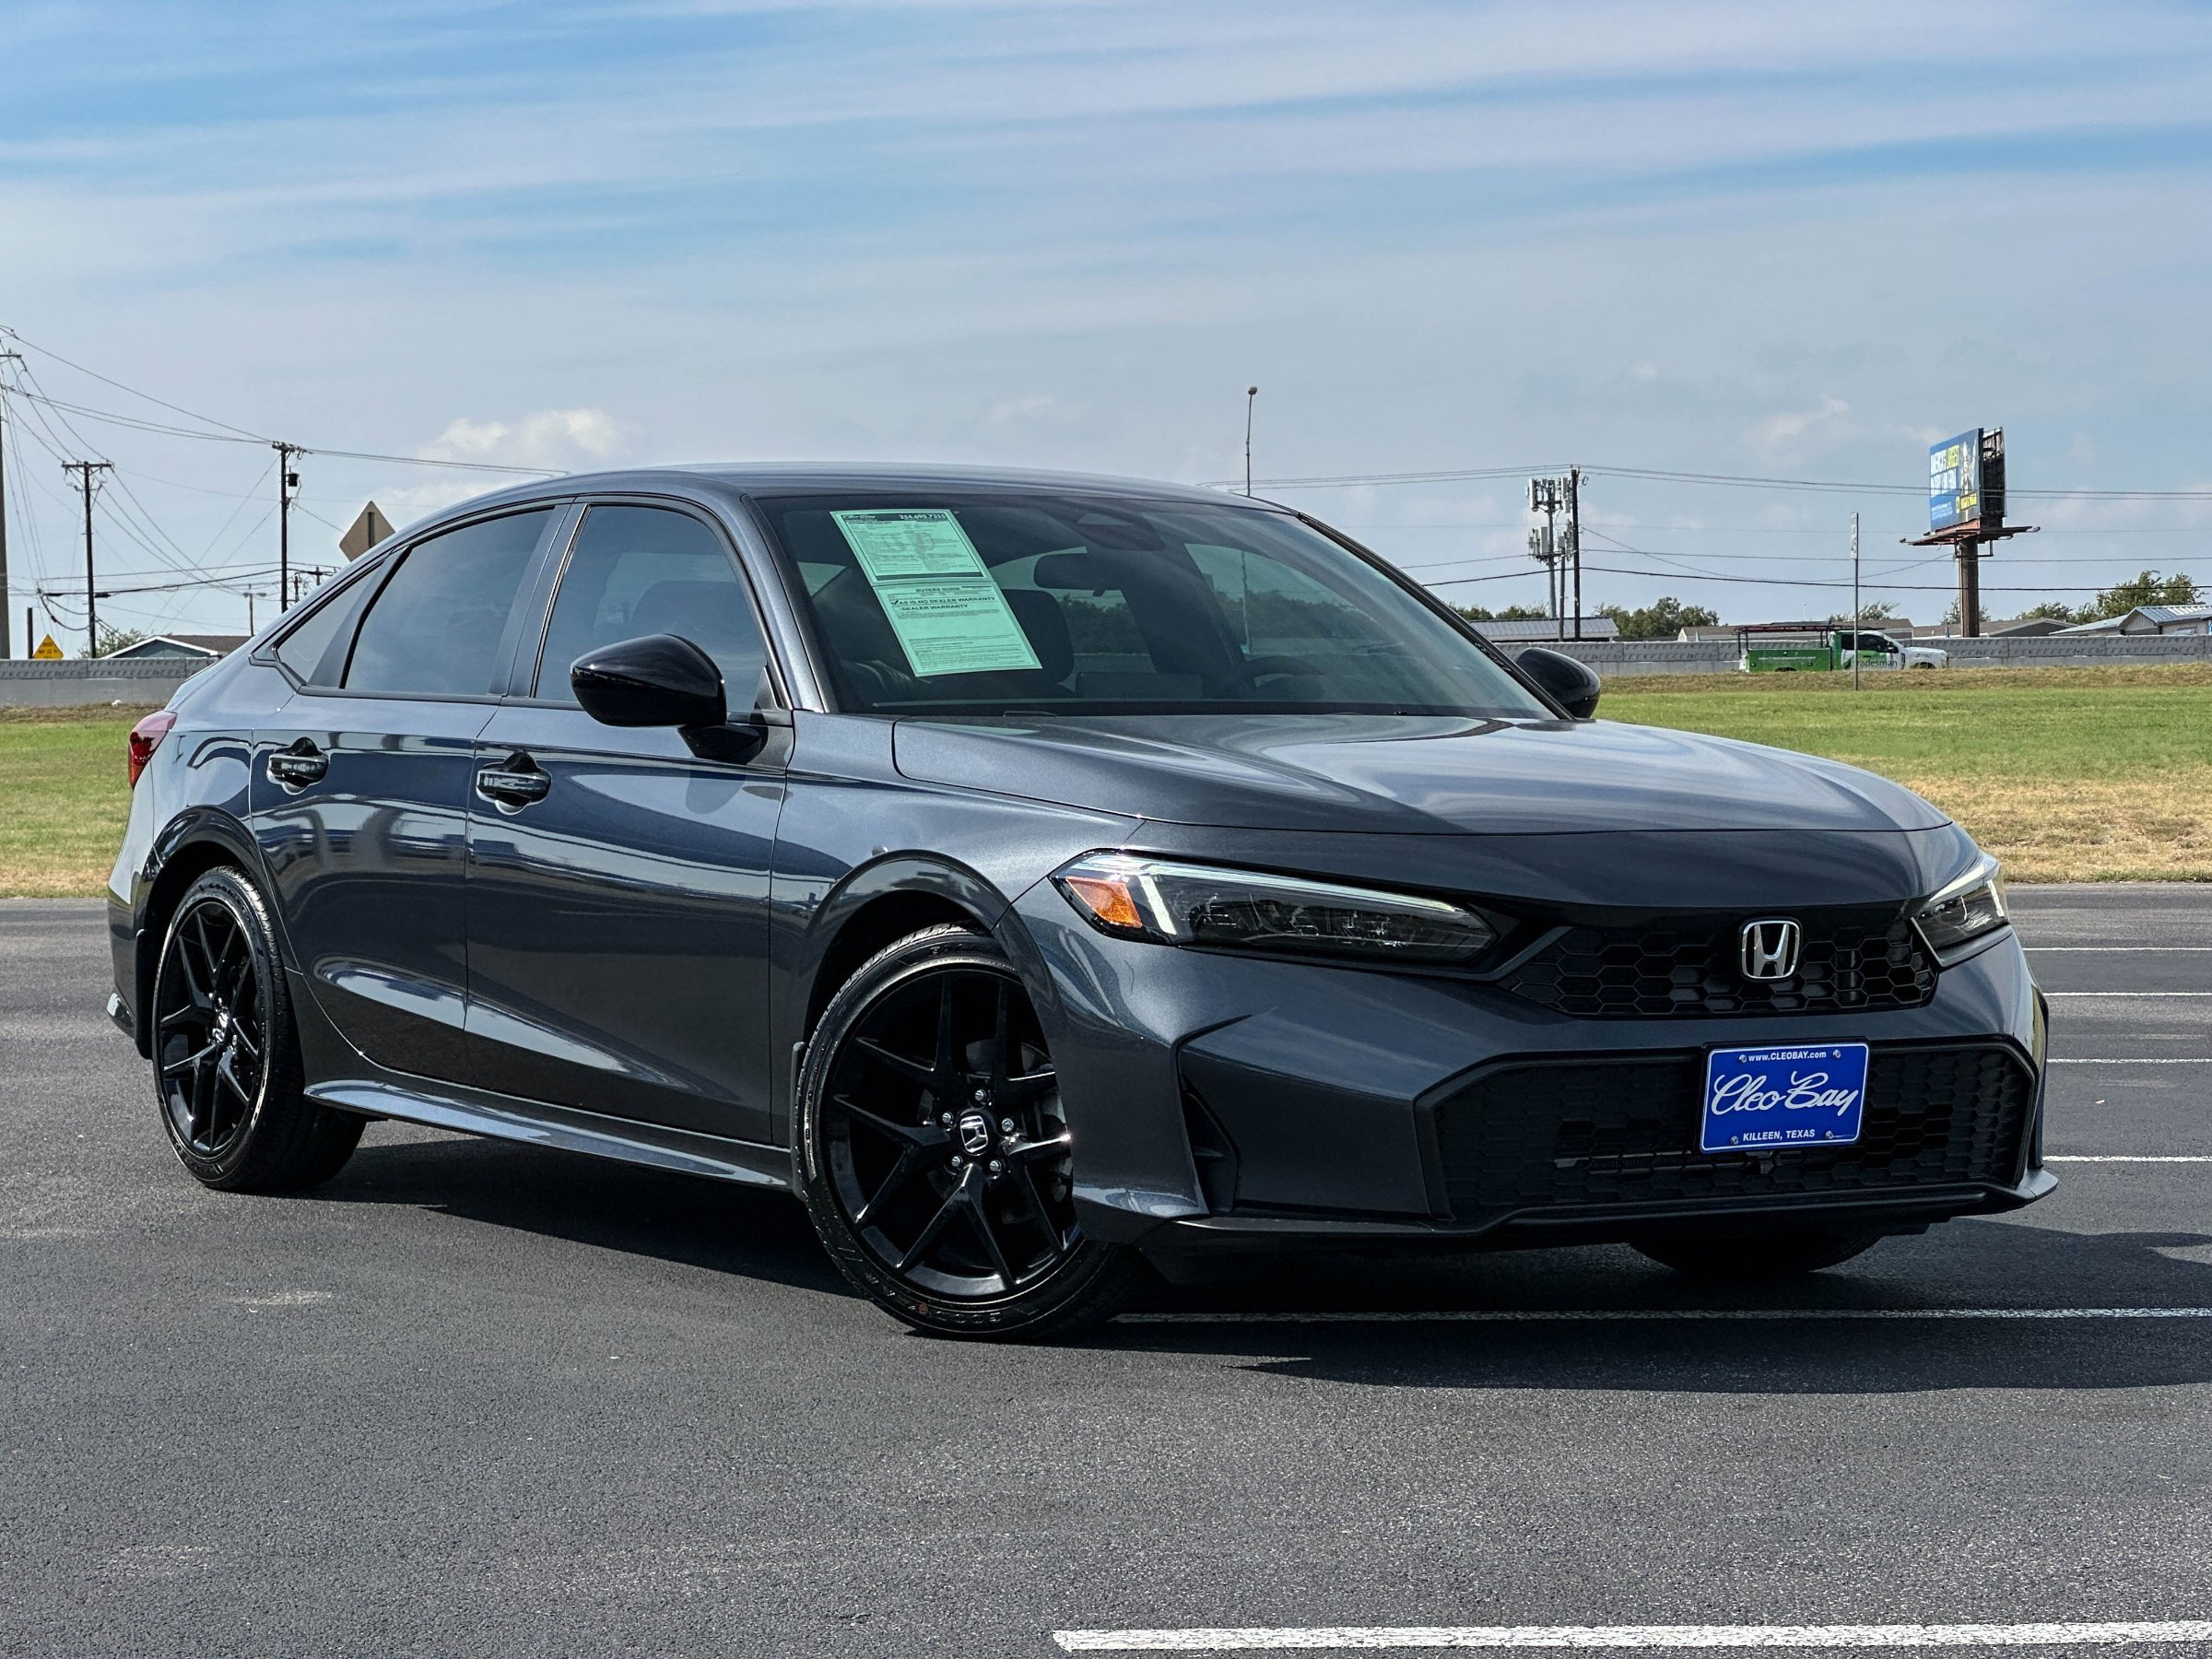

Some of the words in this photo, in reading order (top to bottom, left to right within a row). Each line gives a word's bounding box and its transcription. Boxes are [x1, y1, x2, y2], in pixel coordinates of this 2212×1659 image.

[1747, 1050, 1827, 1063] www.CLEOBAY.com
[1711, 1073, 1786, 1116] Cleo
[1783, 1070, 1859, 1117] Bay
[1742, 1130, 1783, 1142] KILLEEN,
[1785, 1128, 1816, 1139] TEXAS
